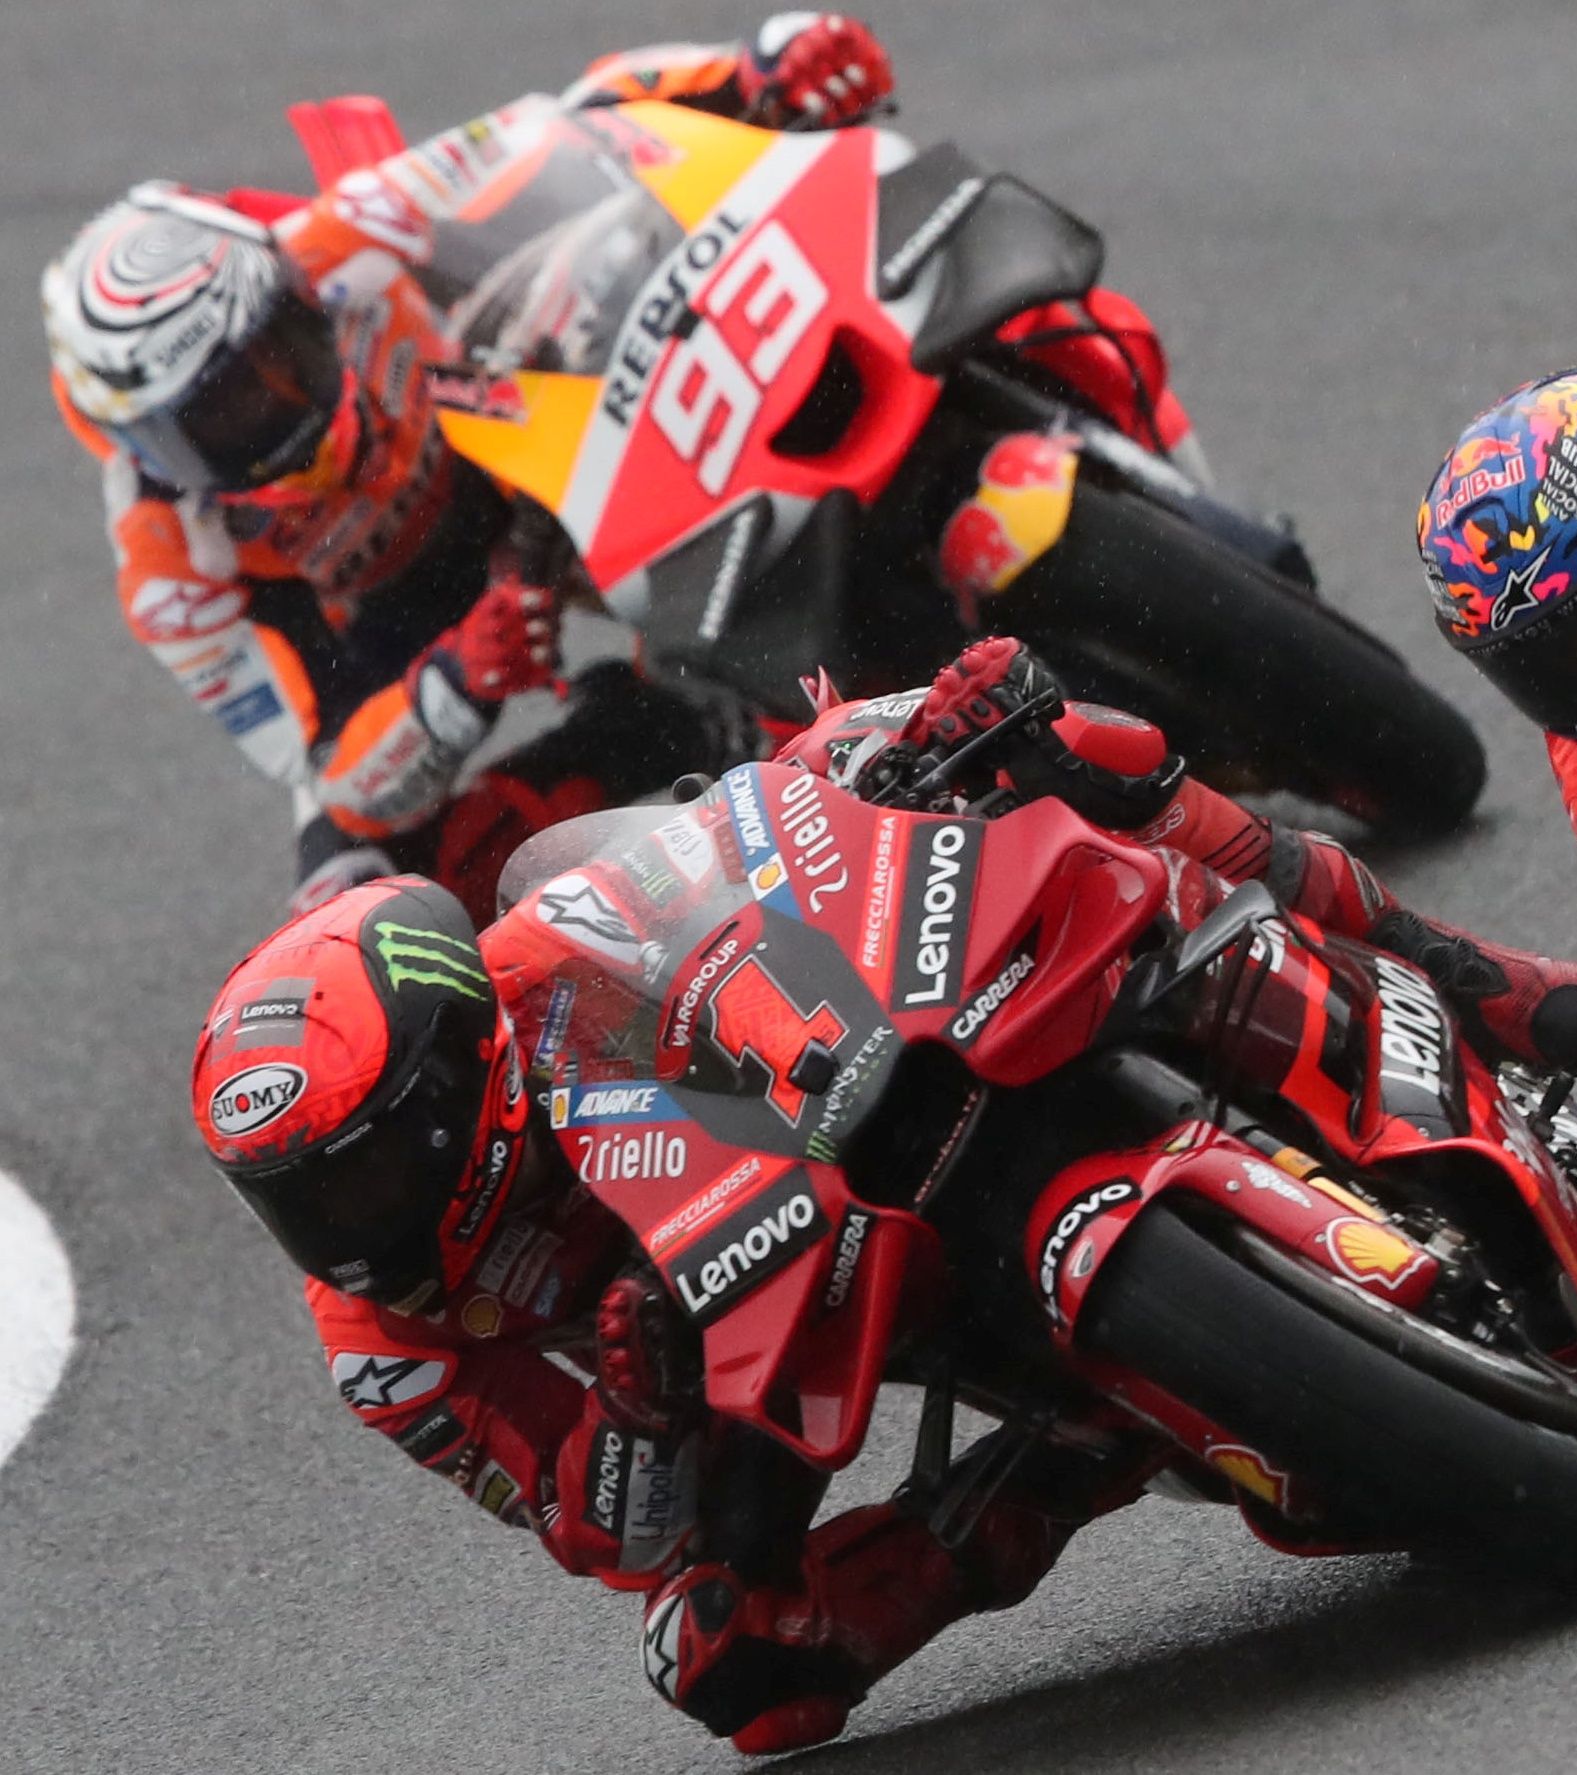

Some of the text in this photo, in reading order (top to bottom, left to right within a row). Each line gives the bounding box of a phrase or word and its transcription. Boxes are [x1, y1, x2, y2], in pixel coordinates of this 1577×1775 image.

[603, 211, 747, 428] REPSOL
[651, 219, 831, 498] 93
[1470, 455, 1525, 499] Bull
[727, 768, 770, 848] ADVANCE
[862, 816, 896, 968] FRECCIAROSSA
[906, 825, 966, 1006] Lenovo
[241, 1003, 299, 1020] Lenovo
[673, 938, 740, 1048] VARGROUP
[709, 953, 850, 1129] 1
[952, 953, 1036, 1041] CARRERA
[1374, 957, 1441, 1095] Lenovo
[212, 1081, 293, 1122] SUOMY
[575, 1086, 660, 1117] ADVANCE
[819, 1026, 893, 1133] MONSTER
[458, 1140, 508, 1237] Lenovo
[650, 1159, 762, 1252] FRECCIAROSSA
[676, 1194, 814, 1313] Lenovo
[826, 1213, 869, 1307] CARRERA
[593, 1431, 624, 1530] Lenovo
